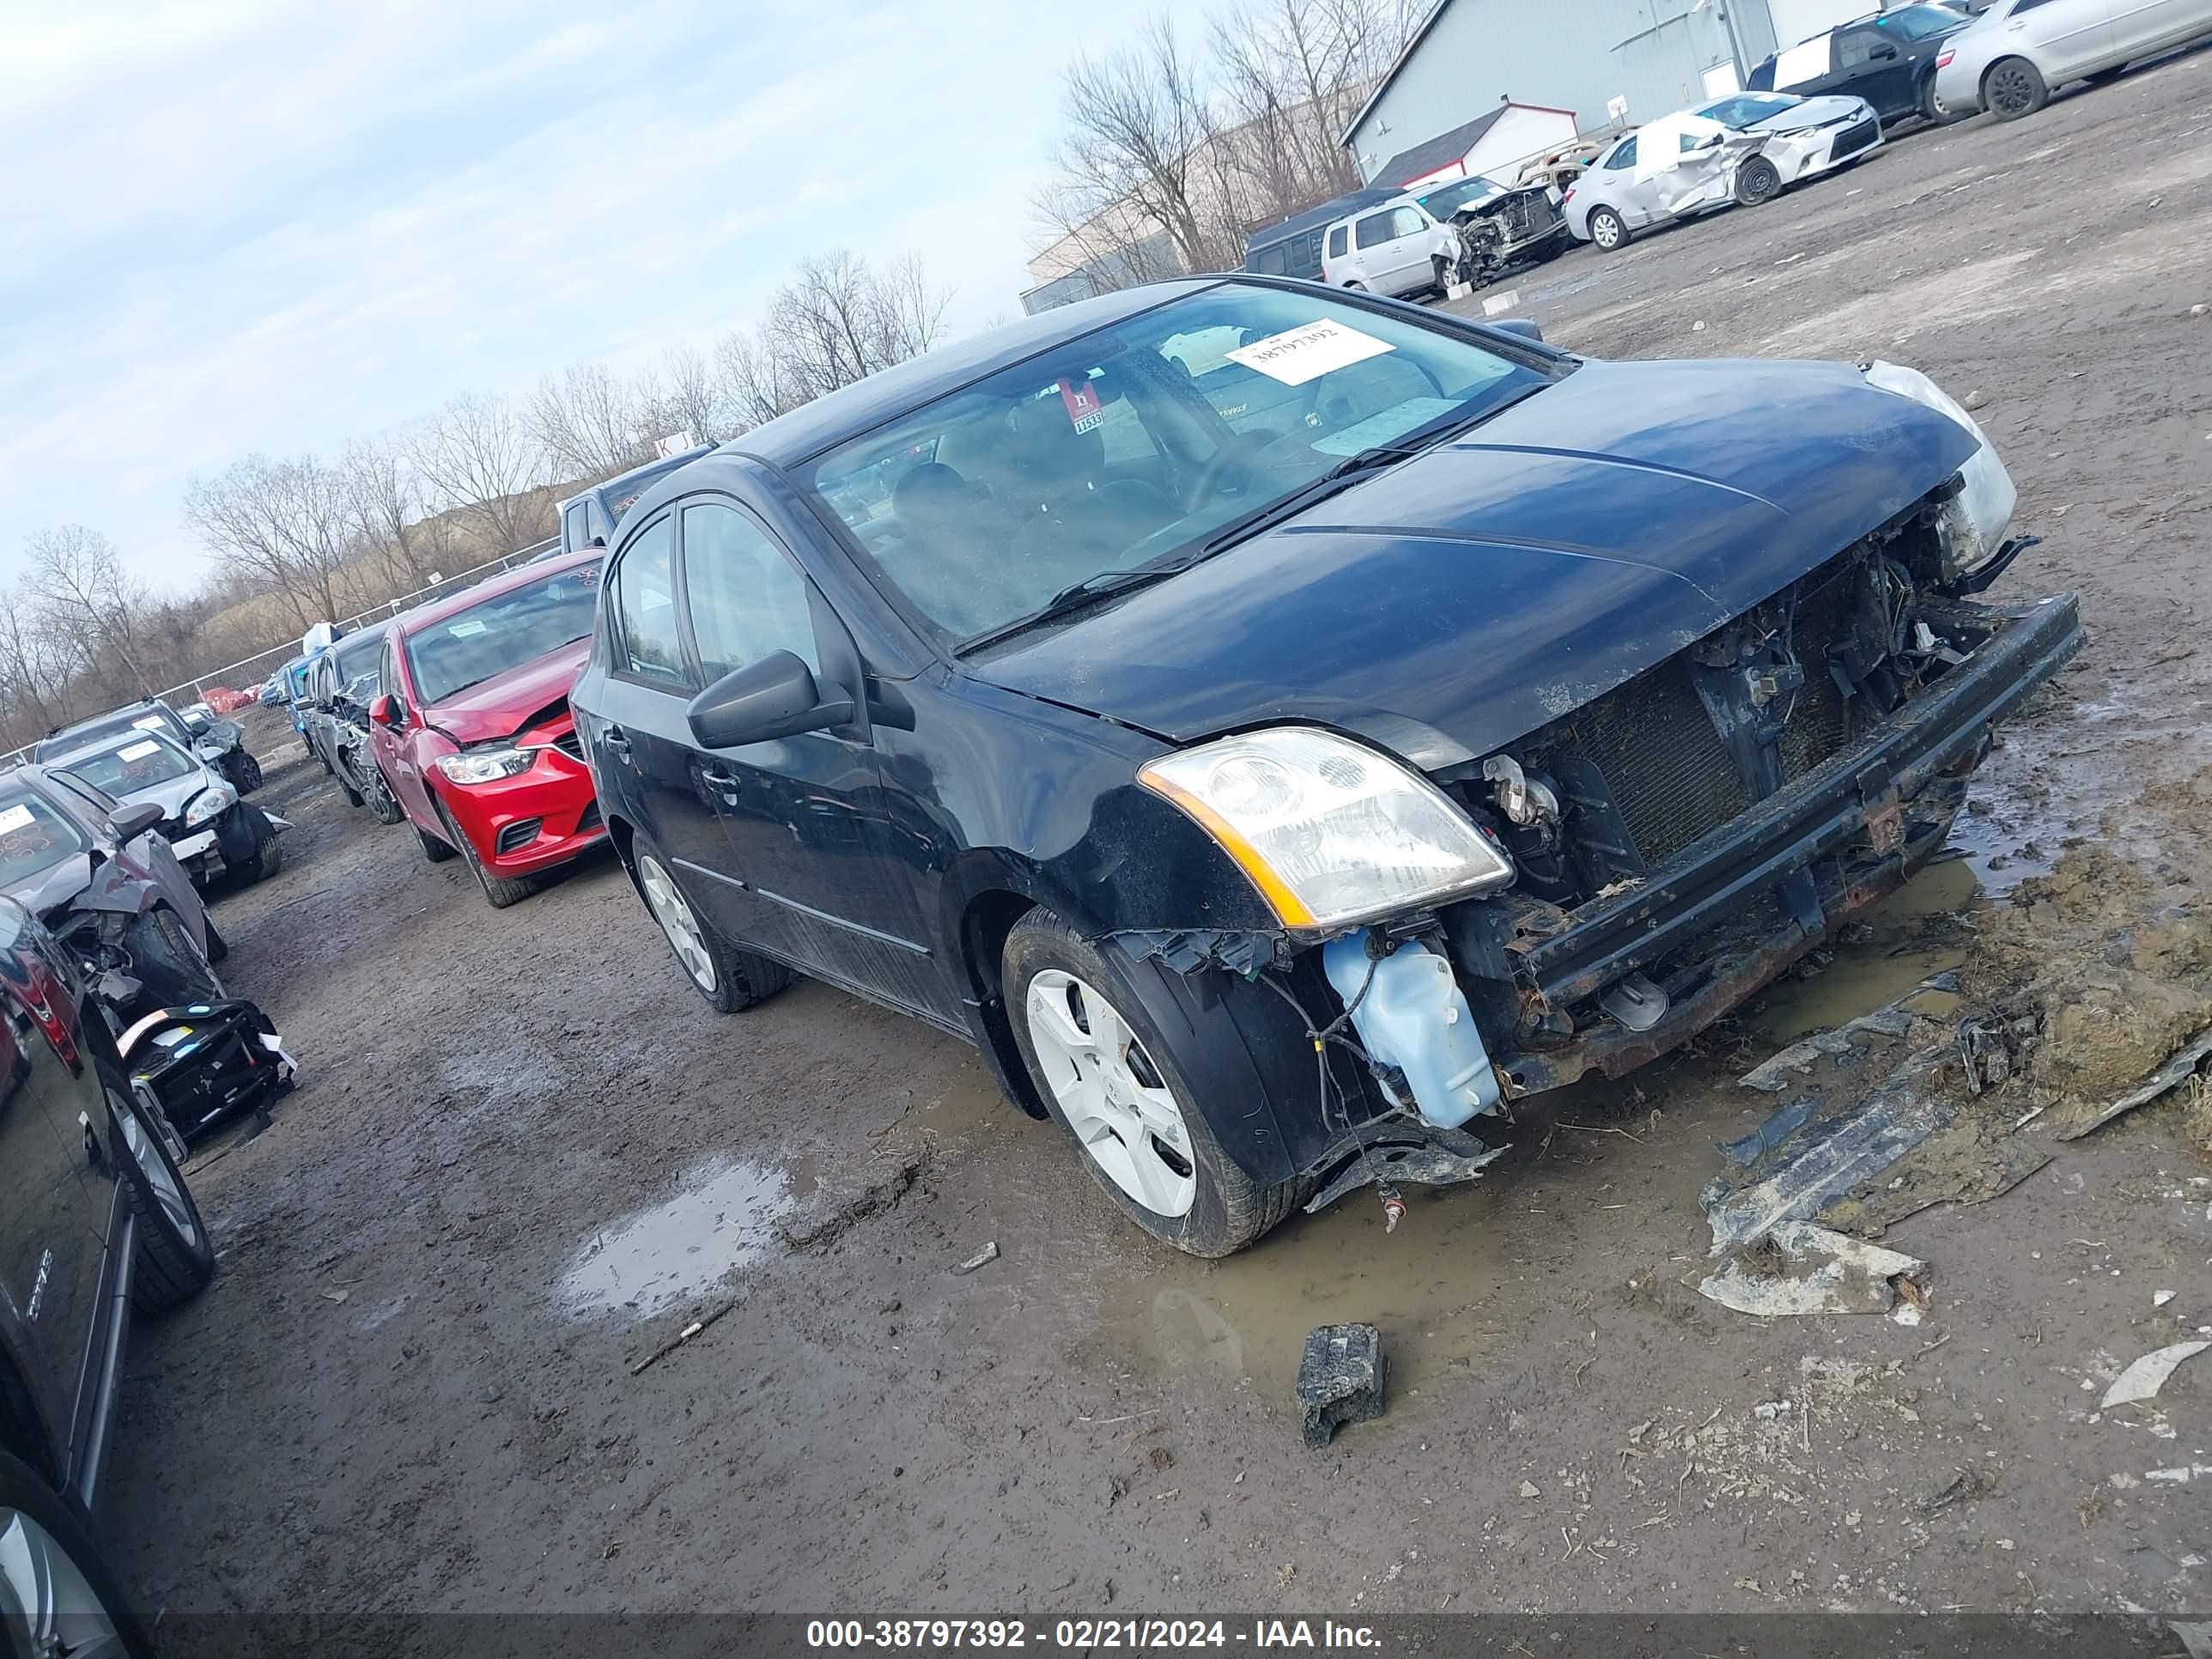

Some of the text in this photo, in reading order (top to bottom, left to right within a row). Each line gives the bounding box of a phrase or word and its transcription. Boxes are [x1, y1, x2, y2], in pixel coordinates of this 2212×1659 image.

[1253, 329, 1338, 362] 38797392
[1076, 414, 1102, 433] 11533
[658, 433, 689, 457] K J
